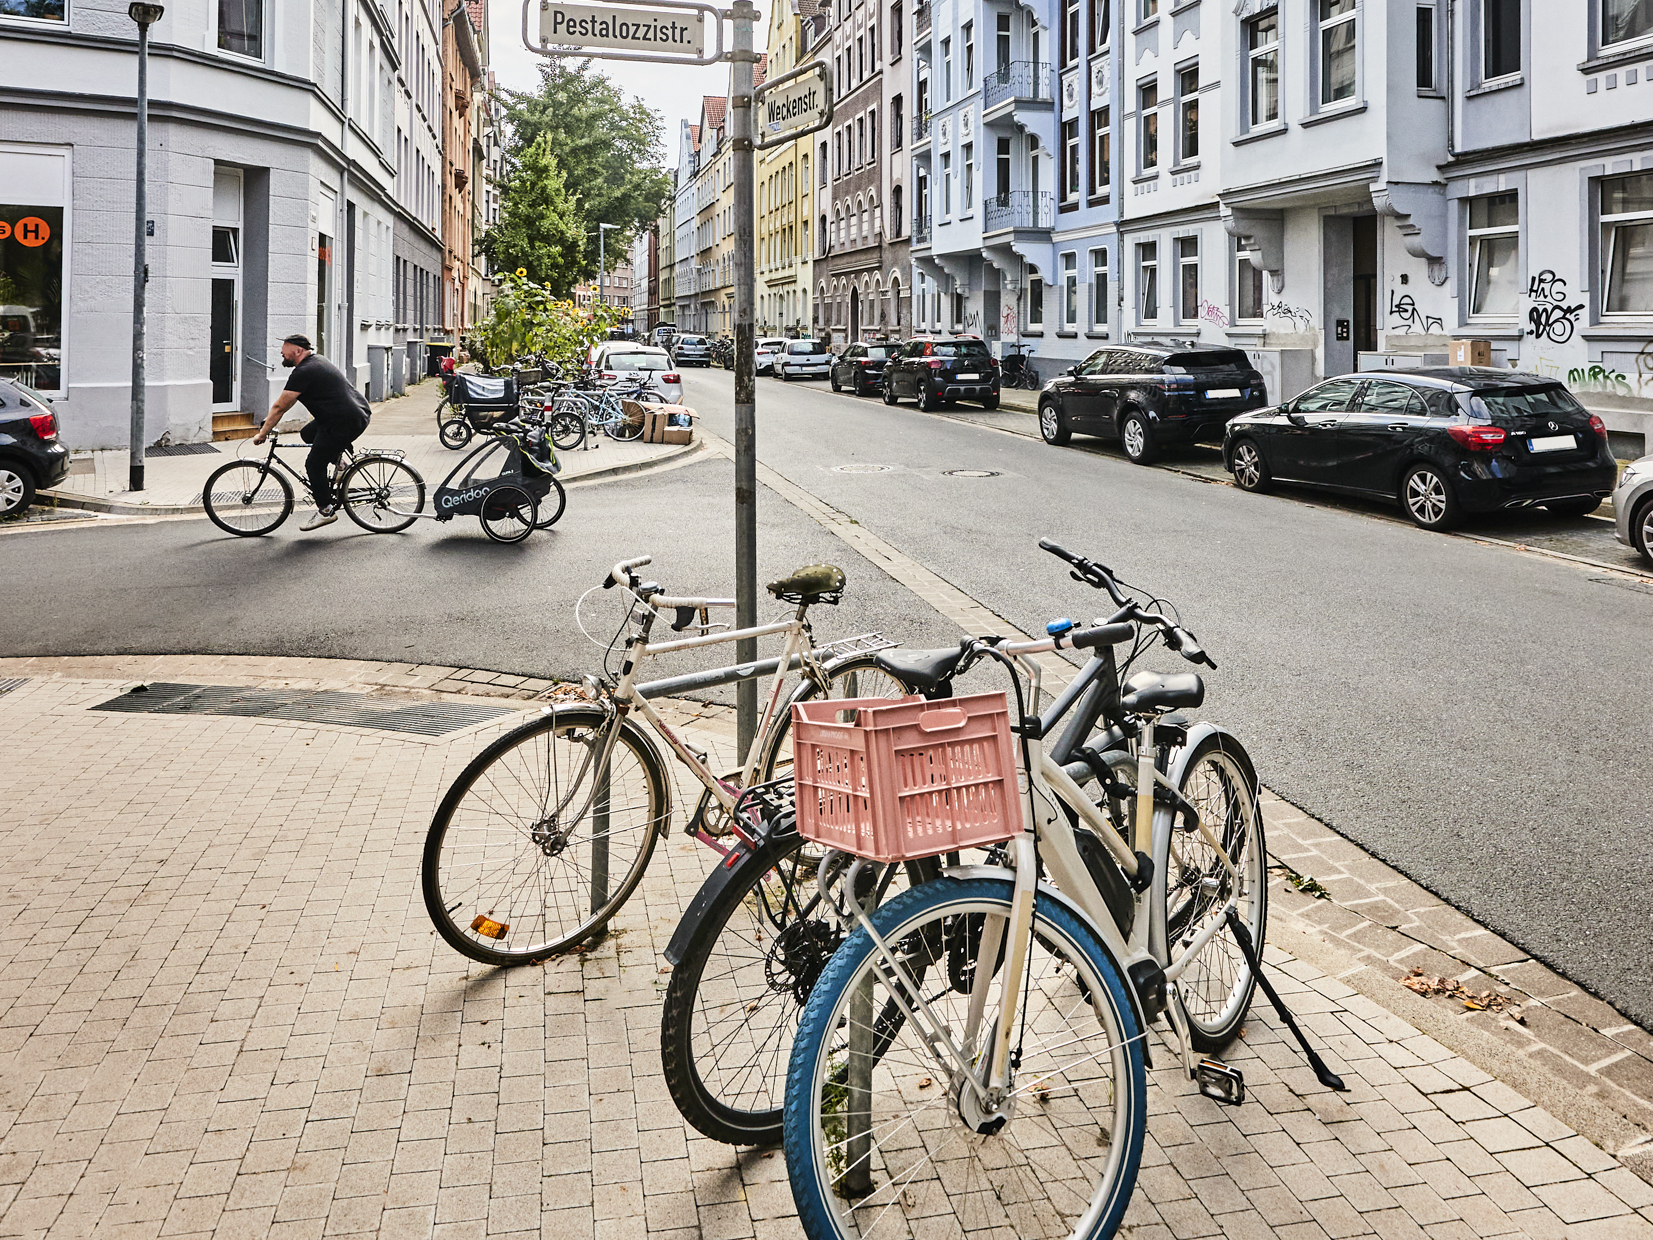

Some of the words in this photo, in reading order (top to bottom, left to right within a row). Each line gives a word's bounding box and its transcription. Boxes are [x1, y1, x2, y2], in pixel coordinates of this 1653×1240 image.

[553, 10, 692, 45] Pestalozzistr.
[767, 86, 819, 123] Weckenstr.
[23, 223, 46, 240] H.
